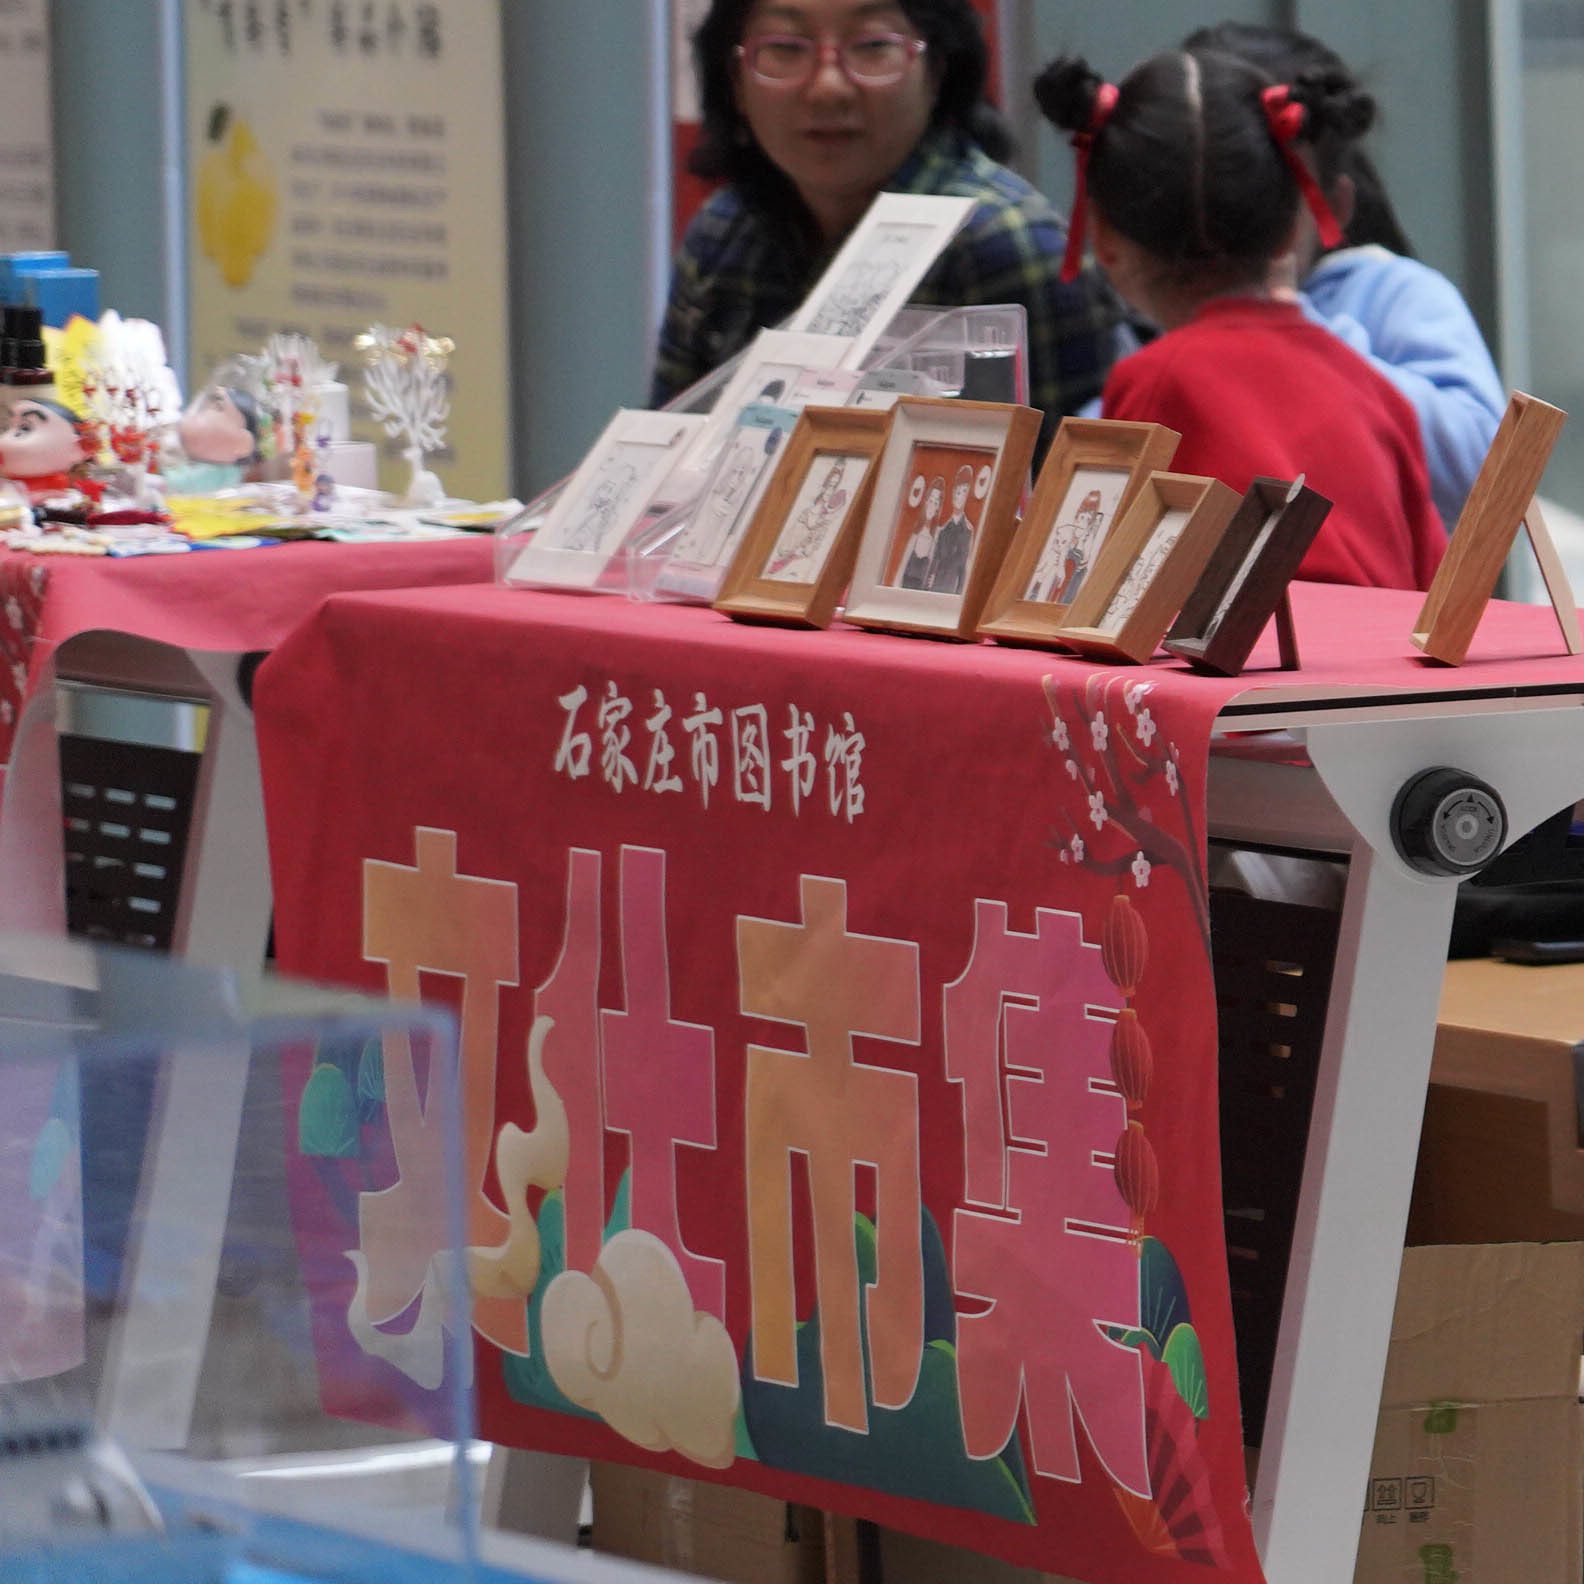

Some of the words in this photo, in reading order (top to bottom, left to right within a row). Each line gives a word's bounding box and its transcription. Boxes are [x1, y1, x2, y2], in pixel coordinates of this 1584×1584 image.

[554, 680, 866, 824] 石家庄市图书馆
